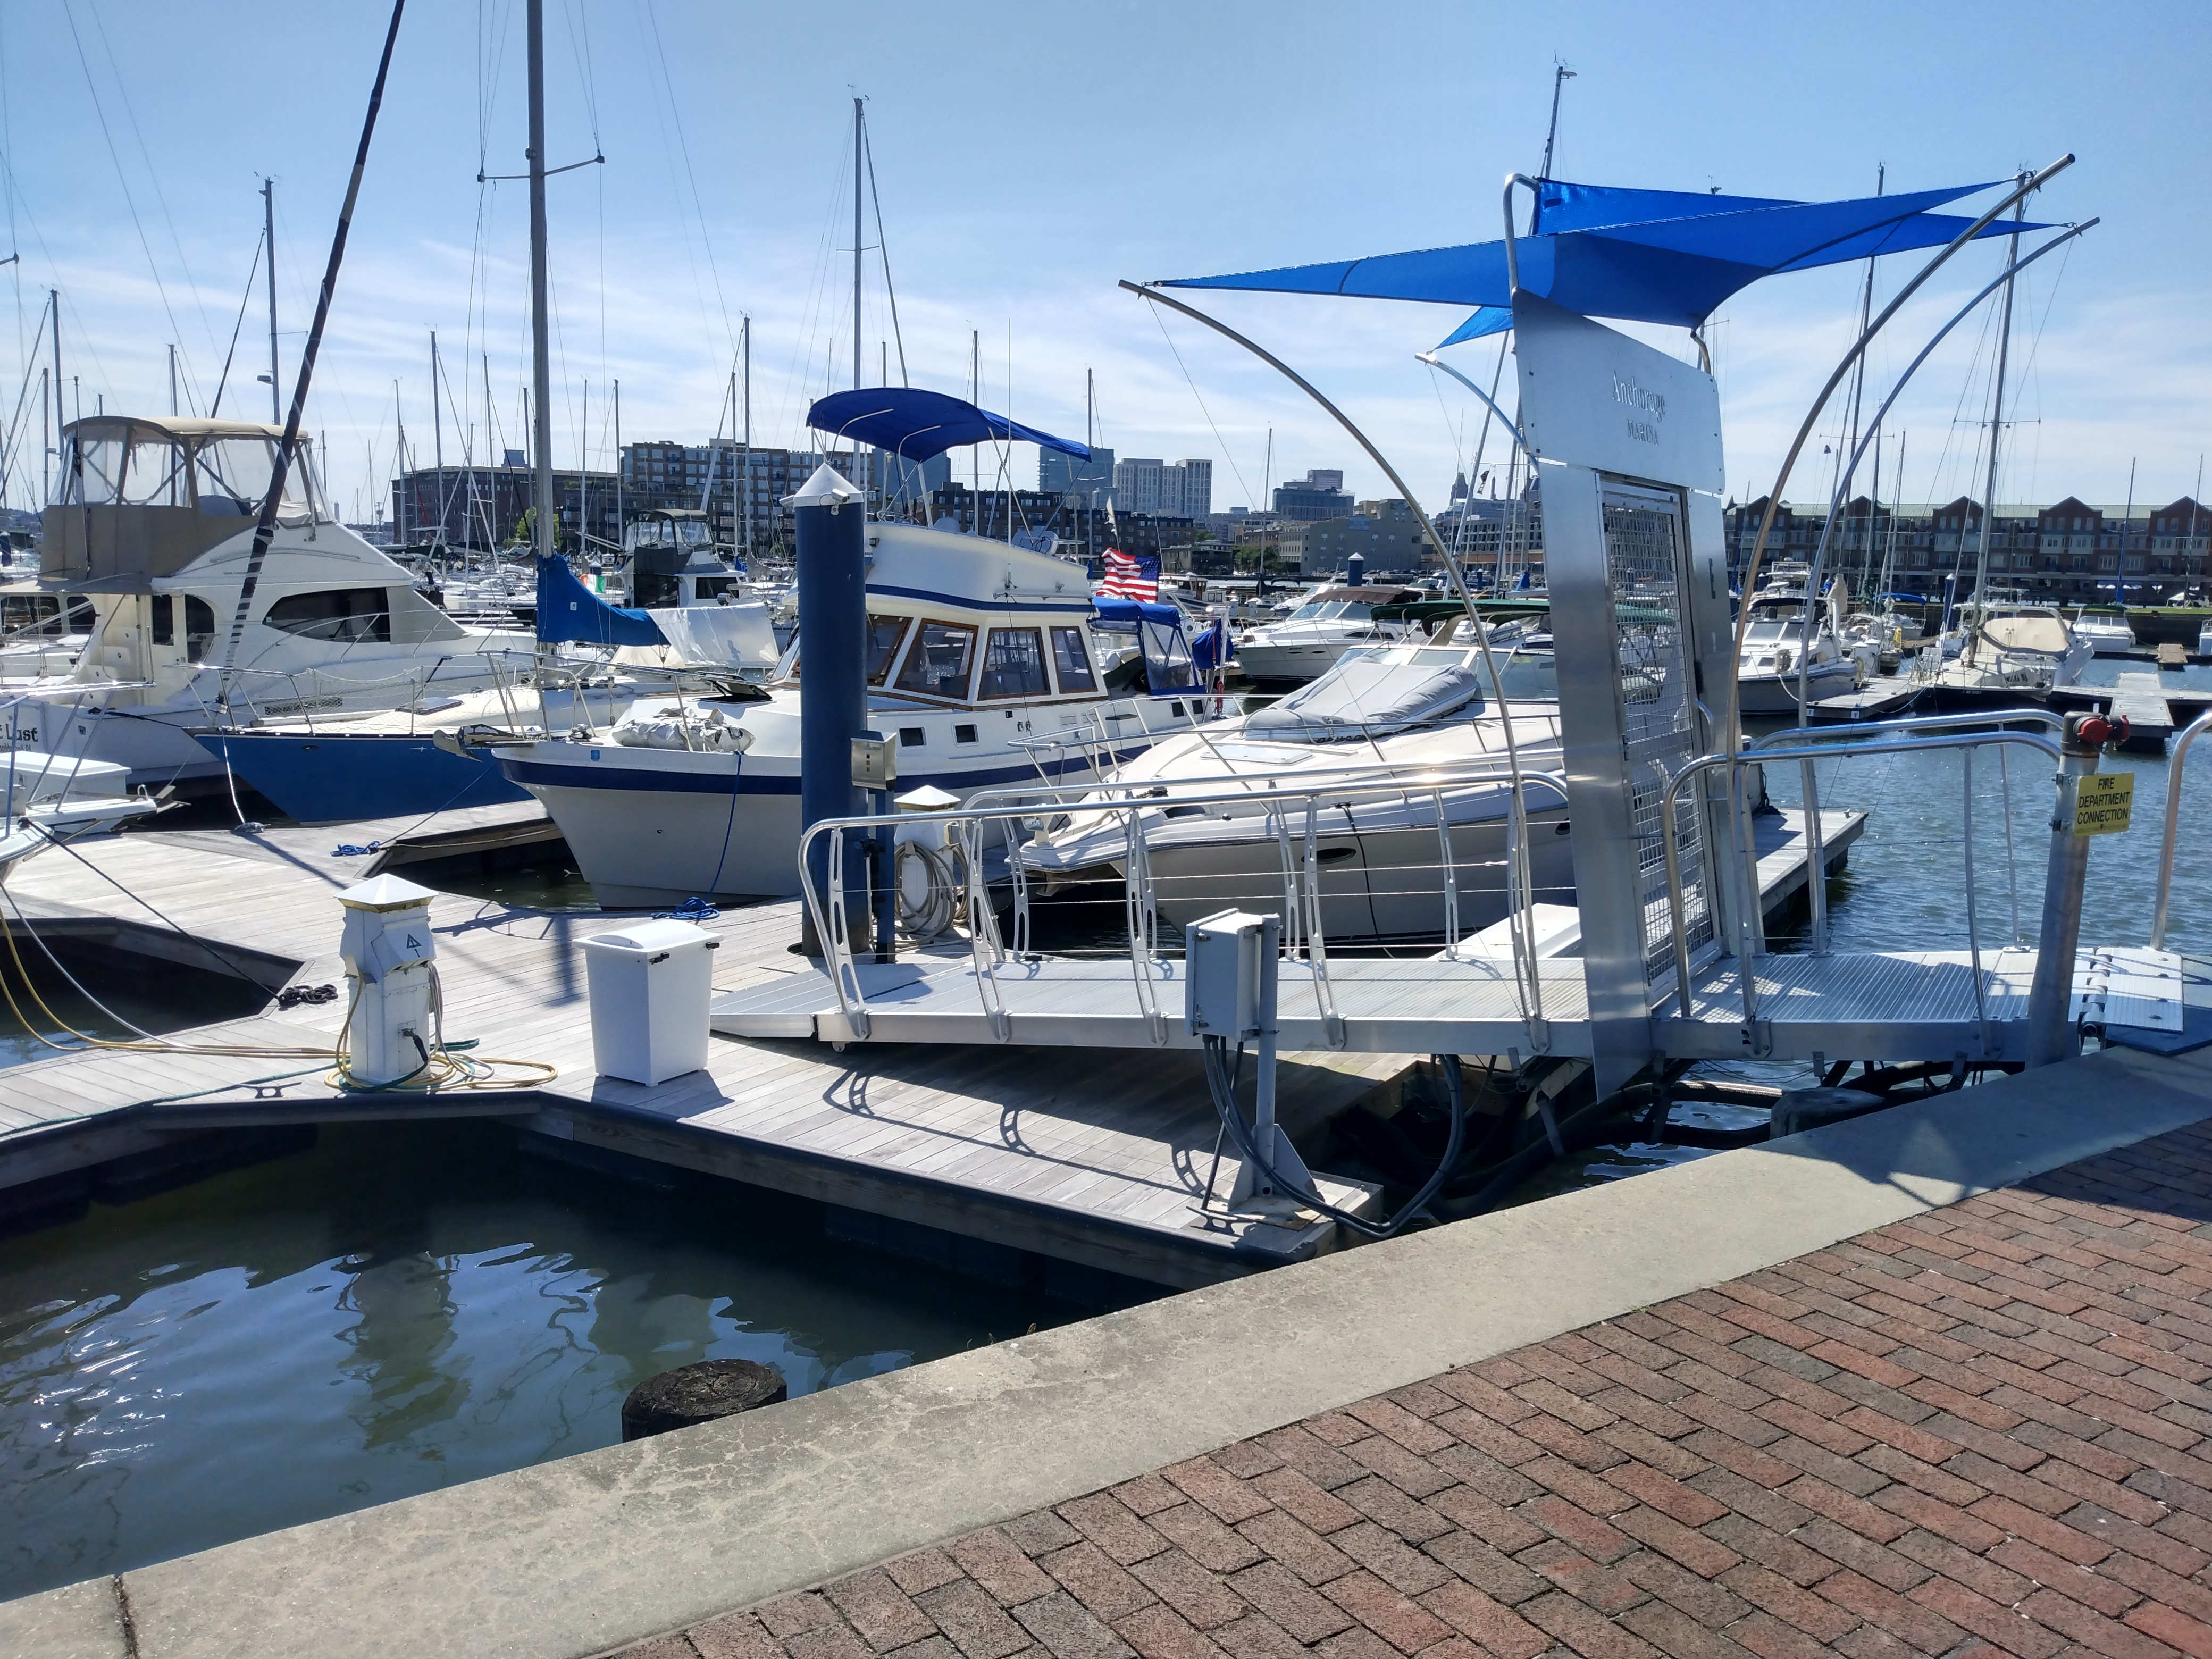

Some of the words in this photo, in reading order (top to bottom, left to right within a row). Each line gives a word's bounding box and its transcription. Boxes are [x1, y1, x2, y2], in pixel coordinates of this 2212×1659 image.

[1612, 370, 1666, 423] Anchorage
[1626, 419, 1658, 446] MARINA
[2098, 777, 2115, 791] FIRE
[2079, 791, 2130, 808] DEPARTMENT
[2077, 808, 2129, 824] CONNECTION
